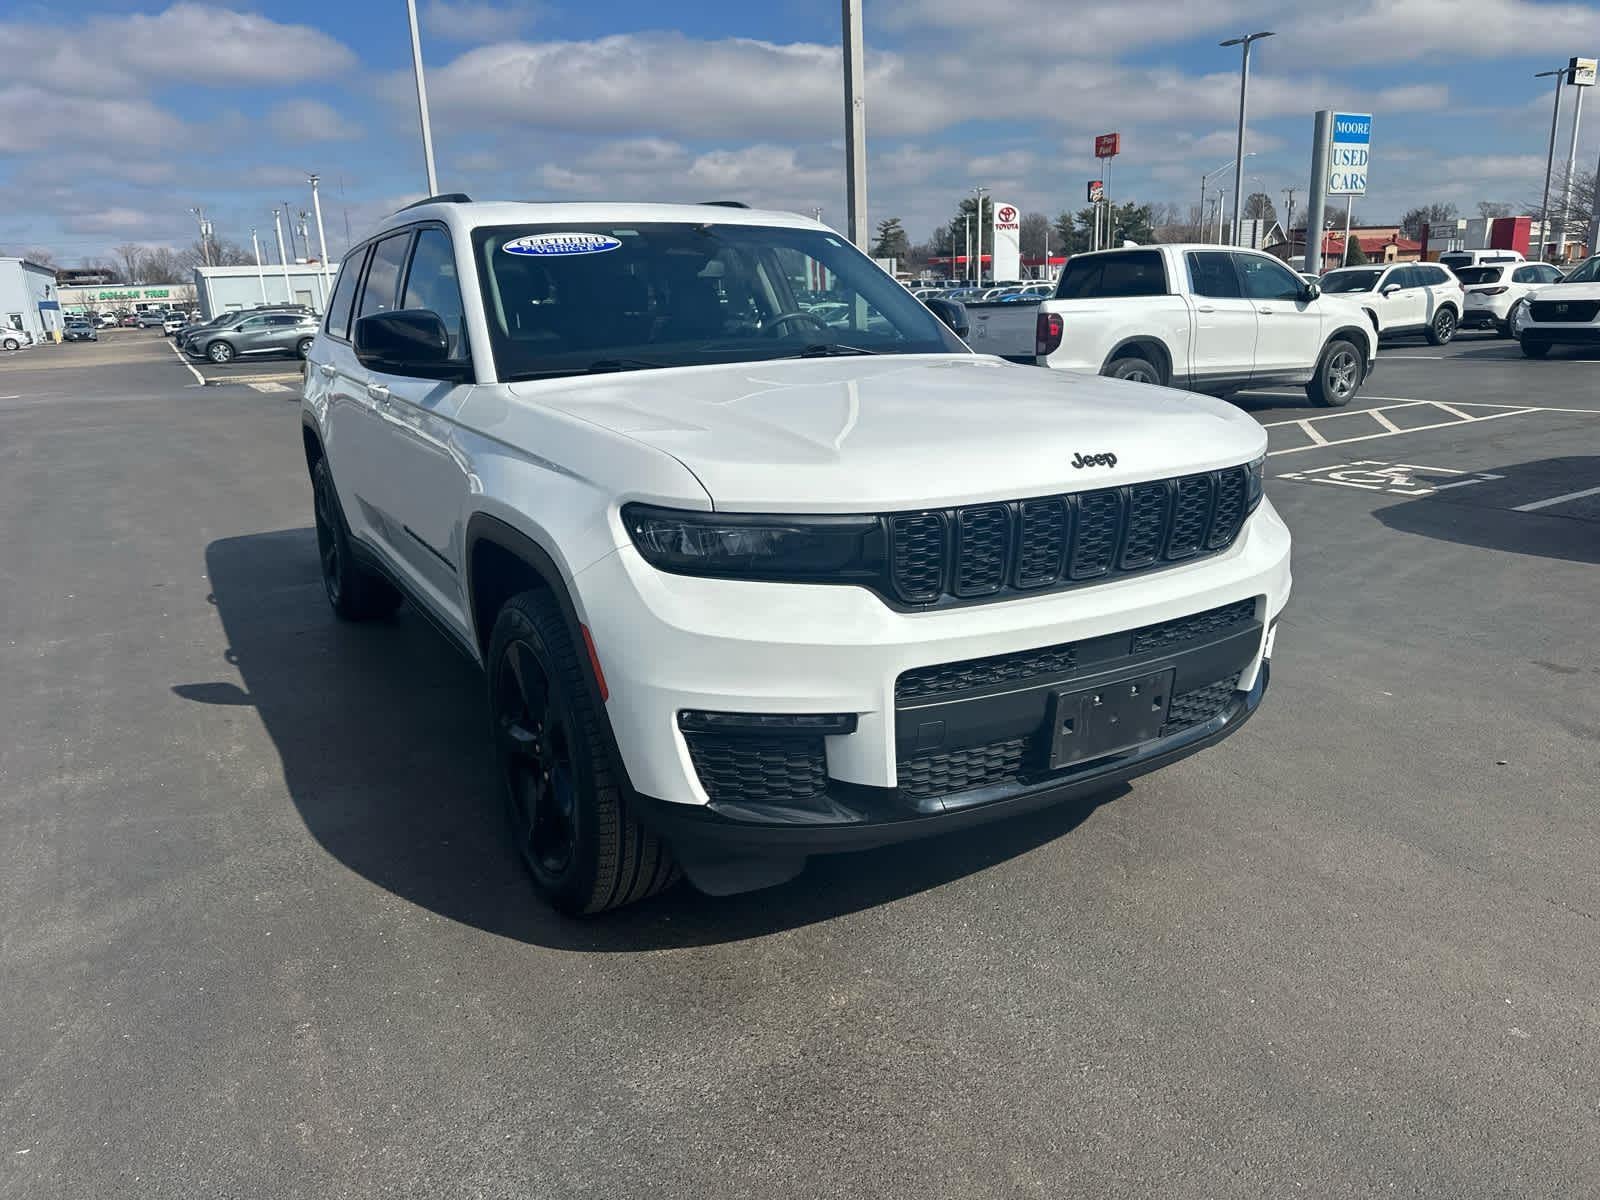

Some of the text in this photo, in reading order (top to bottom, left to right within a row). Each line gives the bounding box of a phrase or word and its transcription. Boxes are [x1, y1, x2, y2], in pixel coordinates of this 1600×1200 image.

[1336, 121, 1369, 134] MOORE
[1333, 149, 1368, 166] USED
[1330, 173, 1367, 190] CARS
[995, 223, 1019, 231] TOYOTA
[517, 236, 607, 247] CERTIFIED
[99, 290, 140, 300] DOLLAR
[1071, 452, 1118, 469] Jeep
